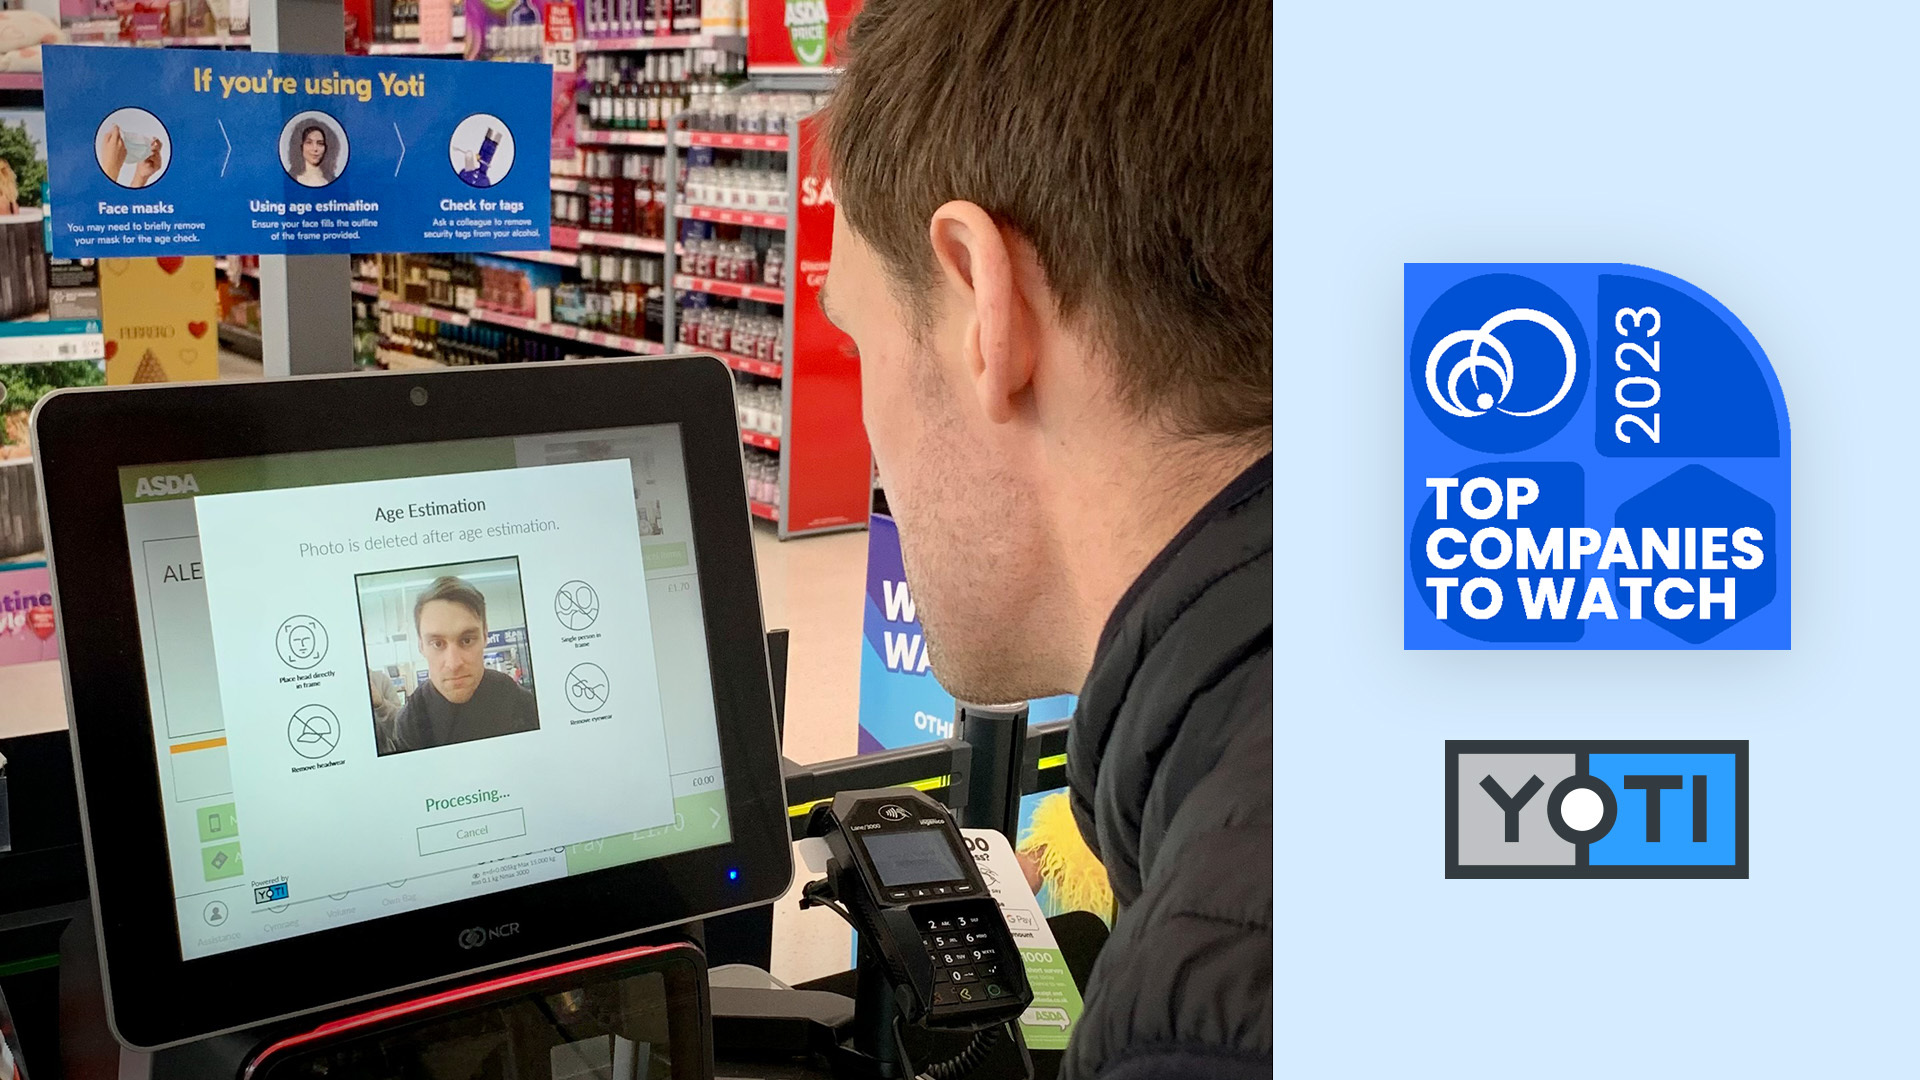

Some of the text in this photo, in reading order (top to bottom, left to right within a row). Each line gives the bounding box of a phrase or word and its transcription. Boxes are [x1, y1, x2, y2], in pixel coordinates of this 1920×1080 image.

[194, 67, 425, 102] If you're using Yoti
[98, 201, 174, 214] Face masks
[250, 200, 379, 215] Using age estimation
[440, 199, 524, 213] Check for tags
[67, 221, 205, 234] You may need to briefly remove
[252, 219, 378, 230] Ensure your face fills the outline
[432, 218, 447, 226] Ask
[456, 218, 492, 228] colleague
[494, 218, 502, 226] to
[75, 233, 200, 246] your mask for the age check.
[271, 231, 360, 241] of the frame provided.
[424, 230, 453, 239] security
[455, 230, 471, 239] tags
[493, 230, 510, 239] your
[512, 229, 540, 237] alcohol.
[120, 326, 175, 340] FERRERO
[136, 474, 199, 498] ASDA
[374, 499, 486, 524] Age Estimation
[299, 519, 560, 558] Photo is deleted after age estimation.
[163, 562, 202, 583] ALE
[668, 582, 690, 593] £1.70
[0, 590, 52, 612] tine
[578, 633, 595, 641] person
[313, 671, 335, 680] directly
[592, 714, 612, 722] eyewear
[291, 760, 346, 773] Remove headwear
[693, 775, 715, 787] £0.00
[426, 789, 510, 812] Processing...
[456, 825, 489, 840] Cancel
[519, 862, 529, 870] Max
[530, 857, 549, 866] 15.000
[500, 872, 515, 880] Nmax
[516, 869, 529, 877] 3000
[251, 876, 280, 888] Powered
[257, 885, 286, 901] YOTI
[327, 907, 357, 918] Volume
[928, 920, 937, 929] 2
[957, 916, 967, 926] 3
[1016, 915, 1032, 926] Pay
[489, 922, 520, 940] NCR
[198, 931, 241, 946] Assistance
[936, 936, 945, 946] 5
[966, 933, 975, 942] 6
[944, 954, 953, 963] 8
[973, 950, 982, 960] 9
[952, 971, 961, 981] 0
[1035, 1010, 1066, 1021] ASDA
